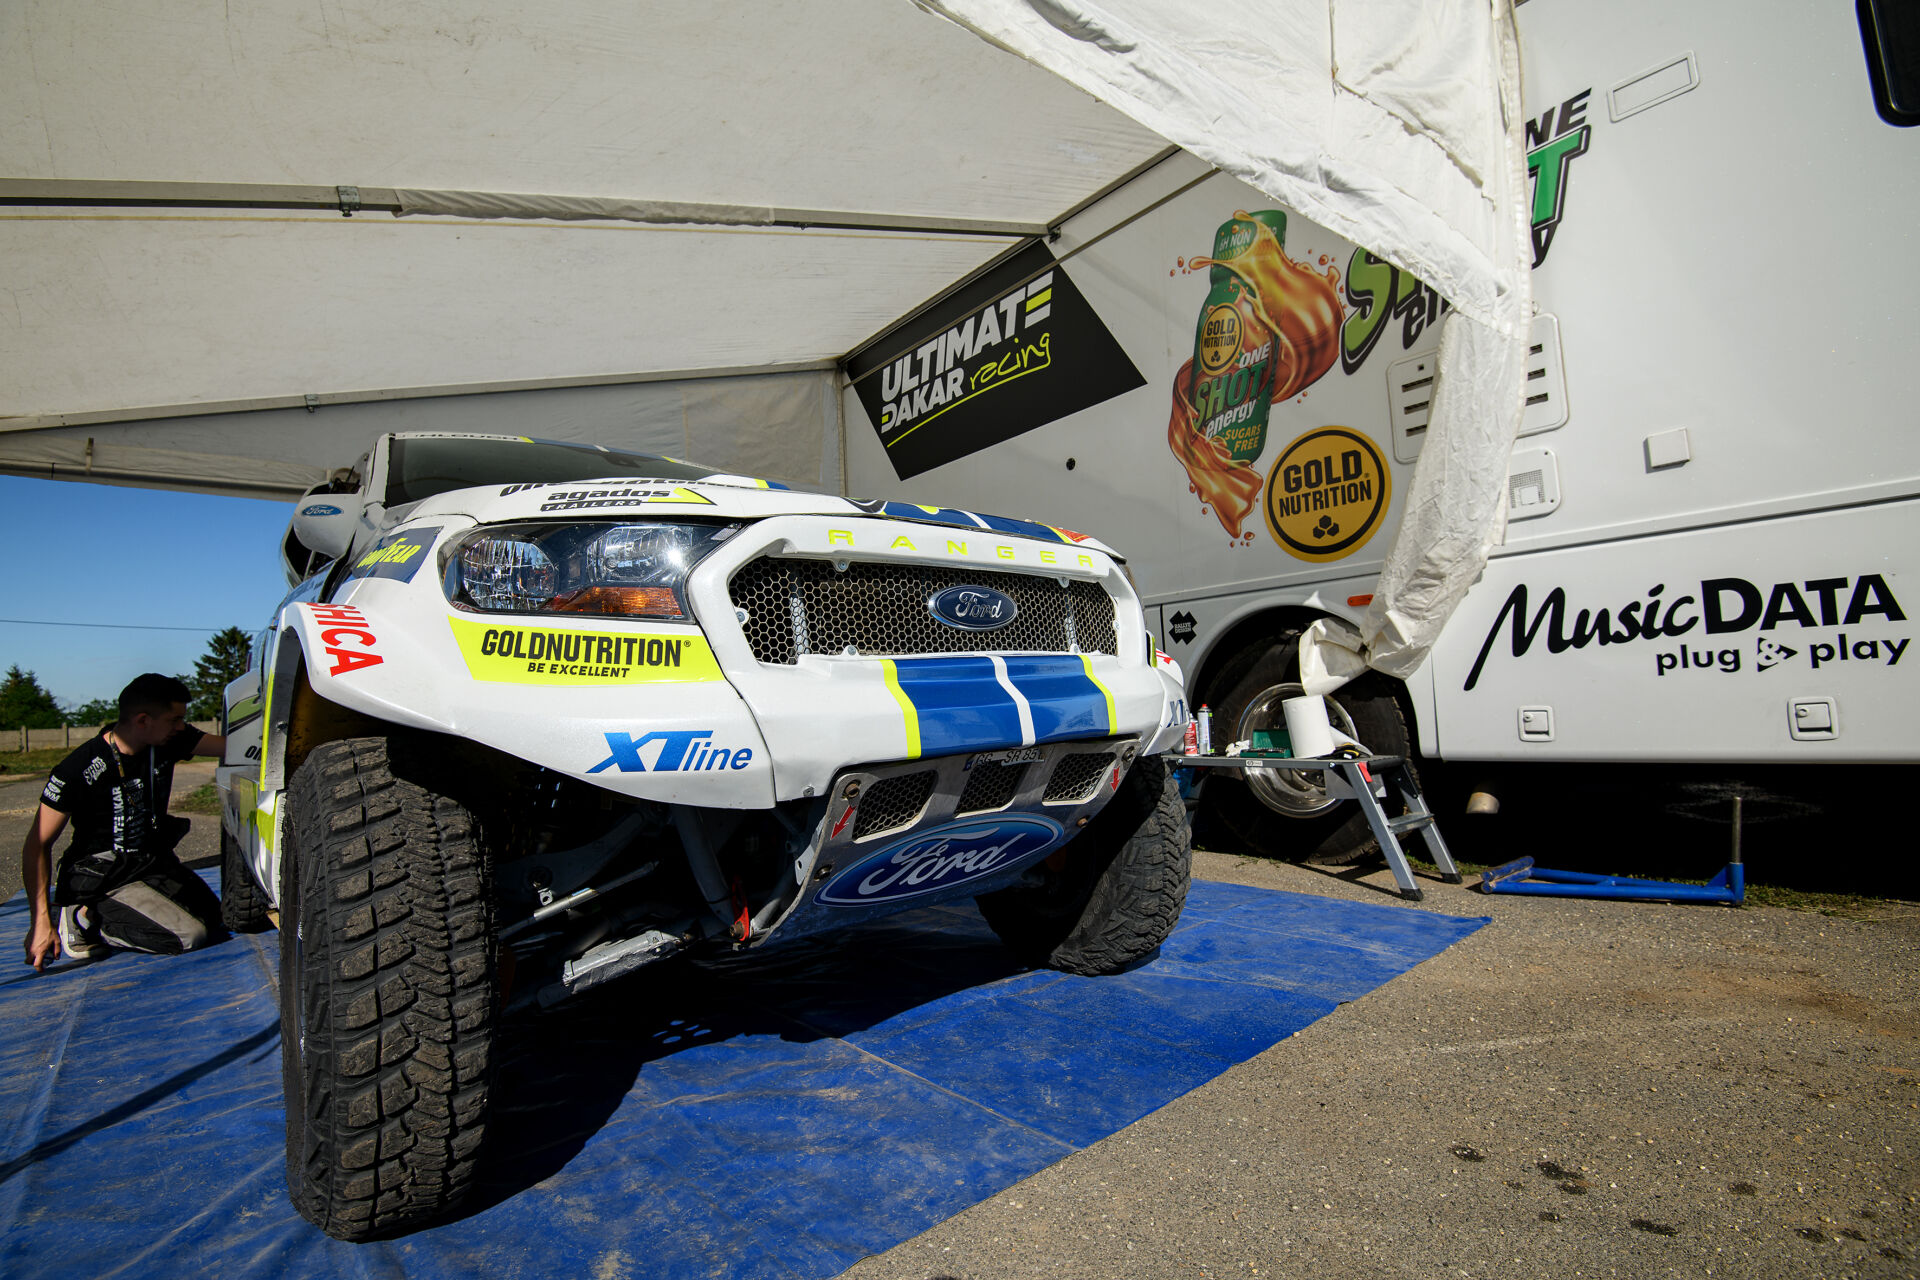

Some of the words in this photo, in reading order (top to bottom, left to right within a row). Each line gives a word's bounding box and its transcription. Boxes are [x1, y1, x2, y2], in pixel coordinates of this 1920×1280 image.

[882, 271, 1053, 402] ULTIMATE
[1204, 333, 1237, 348] NUTRITION
[1206, 318, 1235, 336] GOLD
[1239, 341, 1271, 369] ONE
[881, 368, 965, 434] DAKAR
[970, 332, 1051, 390] racing
[1194, 361, 1268, 427] SHOT
[1205, 399, 1256, 442] energy
[1225, 423, 1261, 441] SUGARS
[1234, 437, 1260, 453] FREE
[1283, 450, 1362, 493] GOLD
[304, 505, 336, 516] Ford
[543, 500, 638, 511] TRAILERS
[548, 487, 671, 502] agados
[1279, 479, 1372, 518] NUTRITION
[828, 529, 1094, 568] RANGER
[955, 591, 1002, 618] Ford
[527, 662, 545, 673] BE
[549, 664, 630, 678] EXCELLENT
[1656, 643, 1741, 676] plug
[1809, 633, 1911, 668] play
[585, 730, 752, 773] XTline
[858, 826, 1028, 895] Ford
